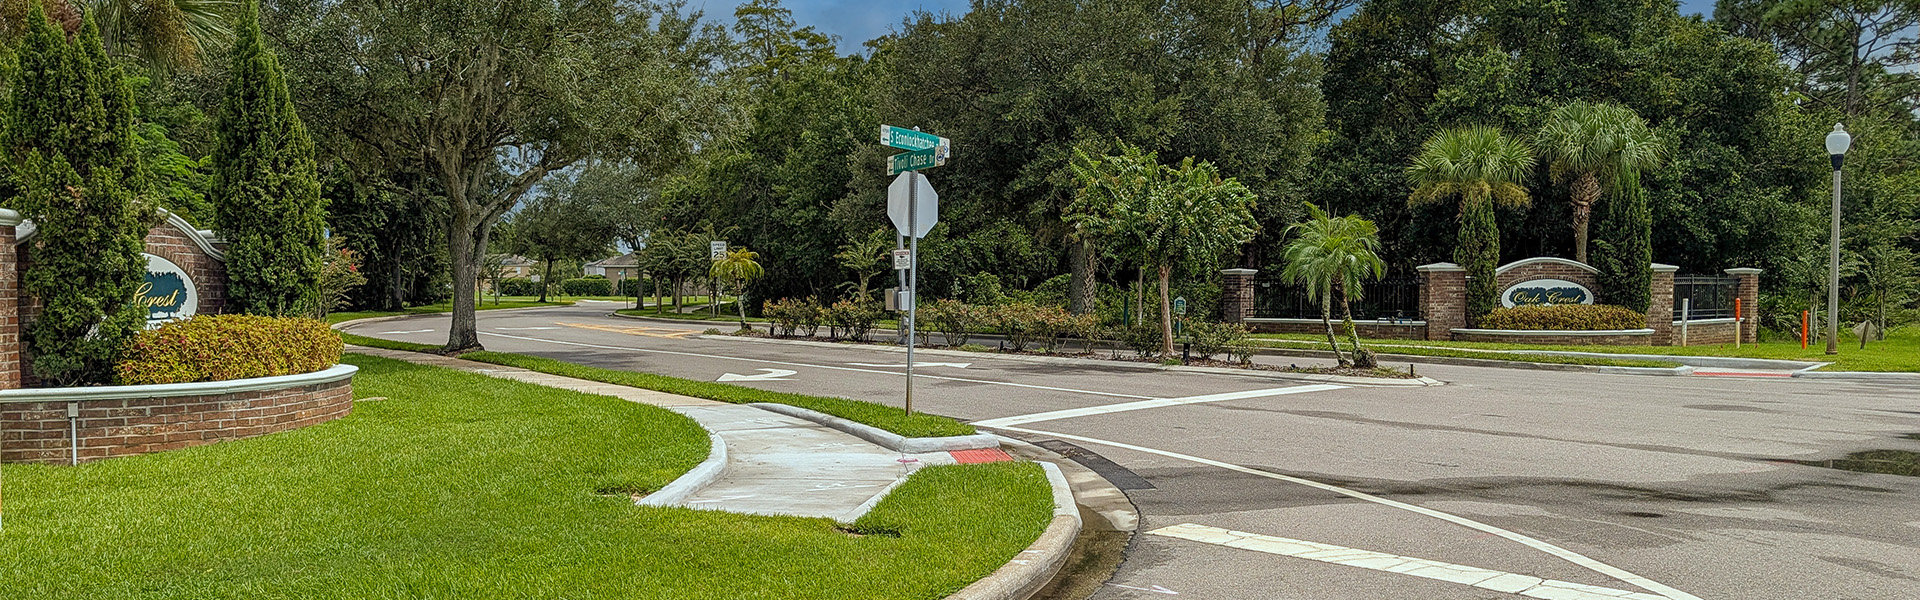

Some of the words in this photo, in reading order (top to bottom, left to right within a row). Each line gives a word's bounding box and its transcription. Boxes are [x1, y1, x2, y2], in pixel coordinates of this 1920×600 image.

[890, 130, 894, 143] S
[894, 155, 909, 170] Tivoli
[910, 153, 927, 167] Chase
[929, 154, 935, 164] Dr
[713, 251, 725, 259] 25
[133, 281, 179, 308] Crest
[1513, 291, 1541, 303] Oak
[1545, 290, 1581, 304] Crest
